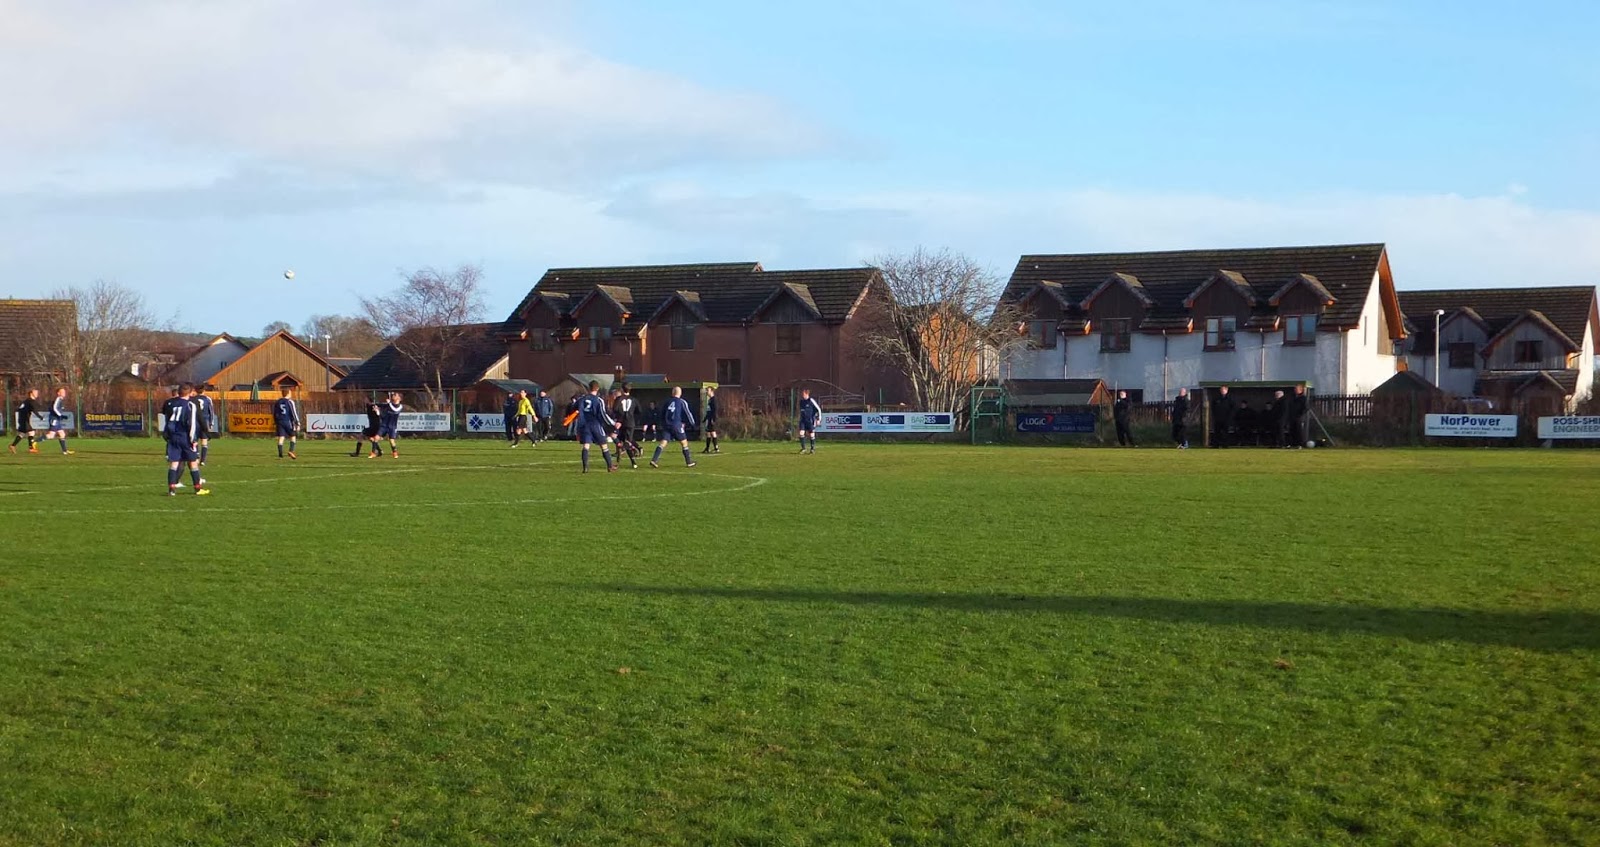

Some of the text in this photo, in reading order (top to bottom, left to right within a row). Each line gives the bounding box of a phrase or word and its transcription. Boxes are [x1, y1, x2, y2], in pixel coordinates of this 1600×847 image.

[280, 404, 287, 415] 5
[584, 399, 592, 412] 2
[667, 401, 676, 413] 4
[85, 413, 141, 421] Stephen Gair
[169, 406, 182, 422] 11
[245, 417, 270, 425] SCOT
[1440, 416, 1501, 426] NorPower
